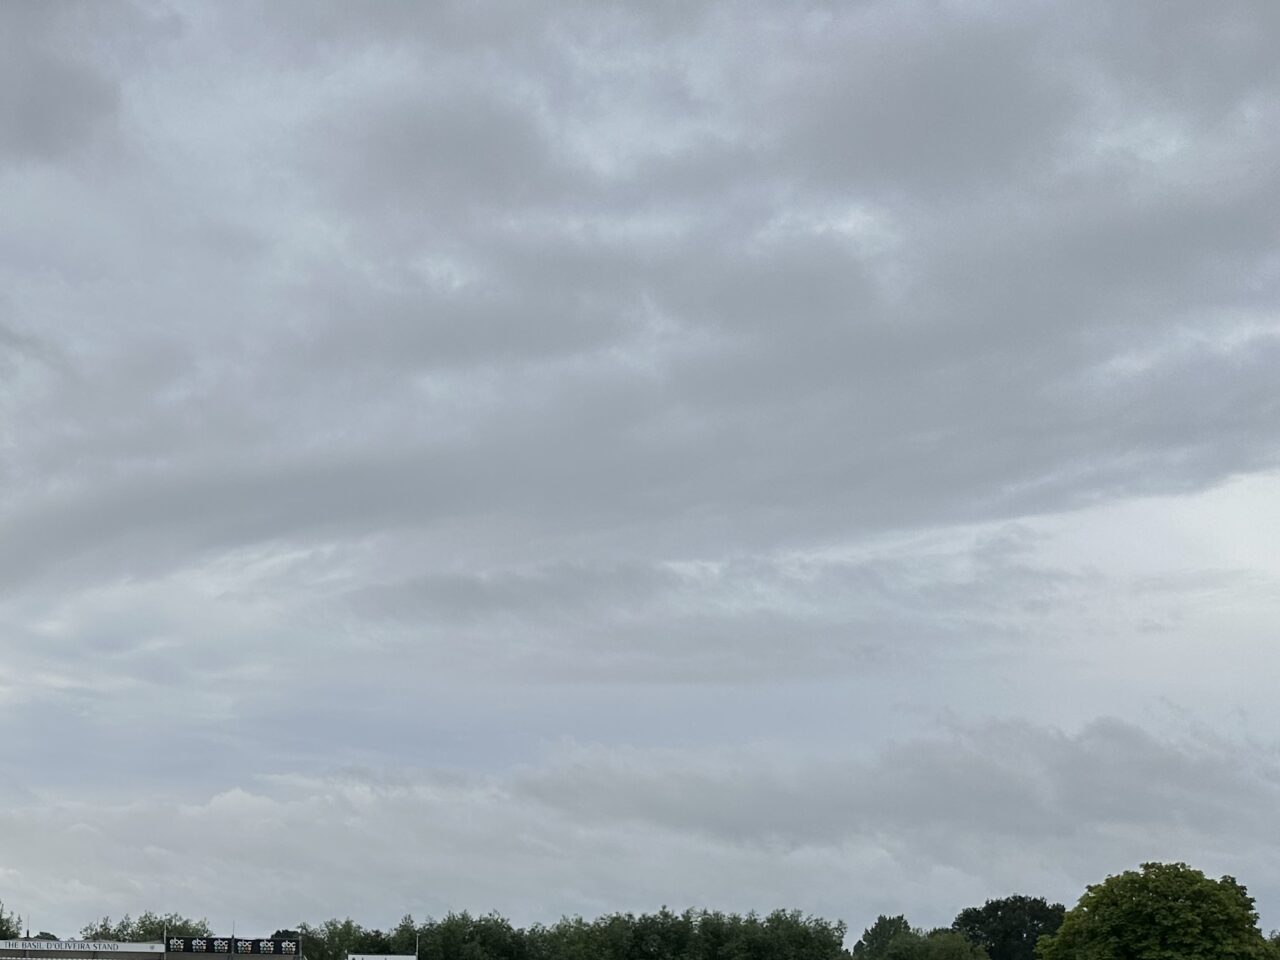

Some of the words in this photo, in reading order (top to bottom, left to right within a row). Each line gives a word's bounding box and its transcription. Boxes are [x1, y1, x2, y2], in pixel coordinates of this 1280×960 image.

[5, 941, 19, 949] THE
[22, 942, 43, 950] BASIL
[46, 942, 90, 951] D'OLIVEIRA
[93, 943, 119, 951] STAND
[192, 938, 207, 946] ebc
[237, 939, 252, 947] ebc
[282, 940, 297, 948] ebc
